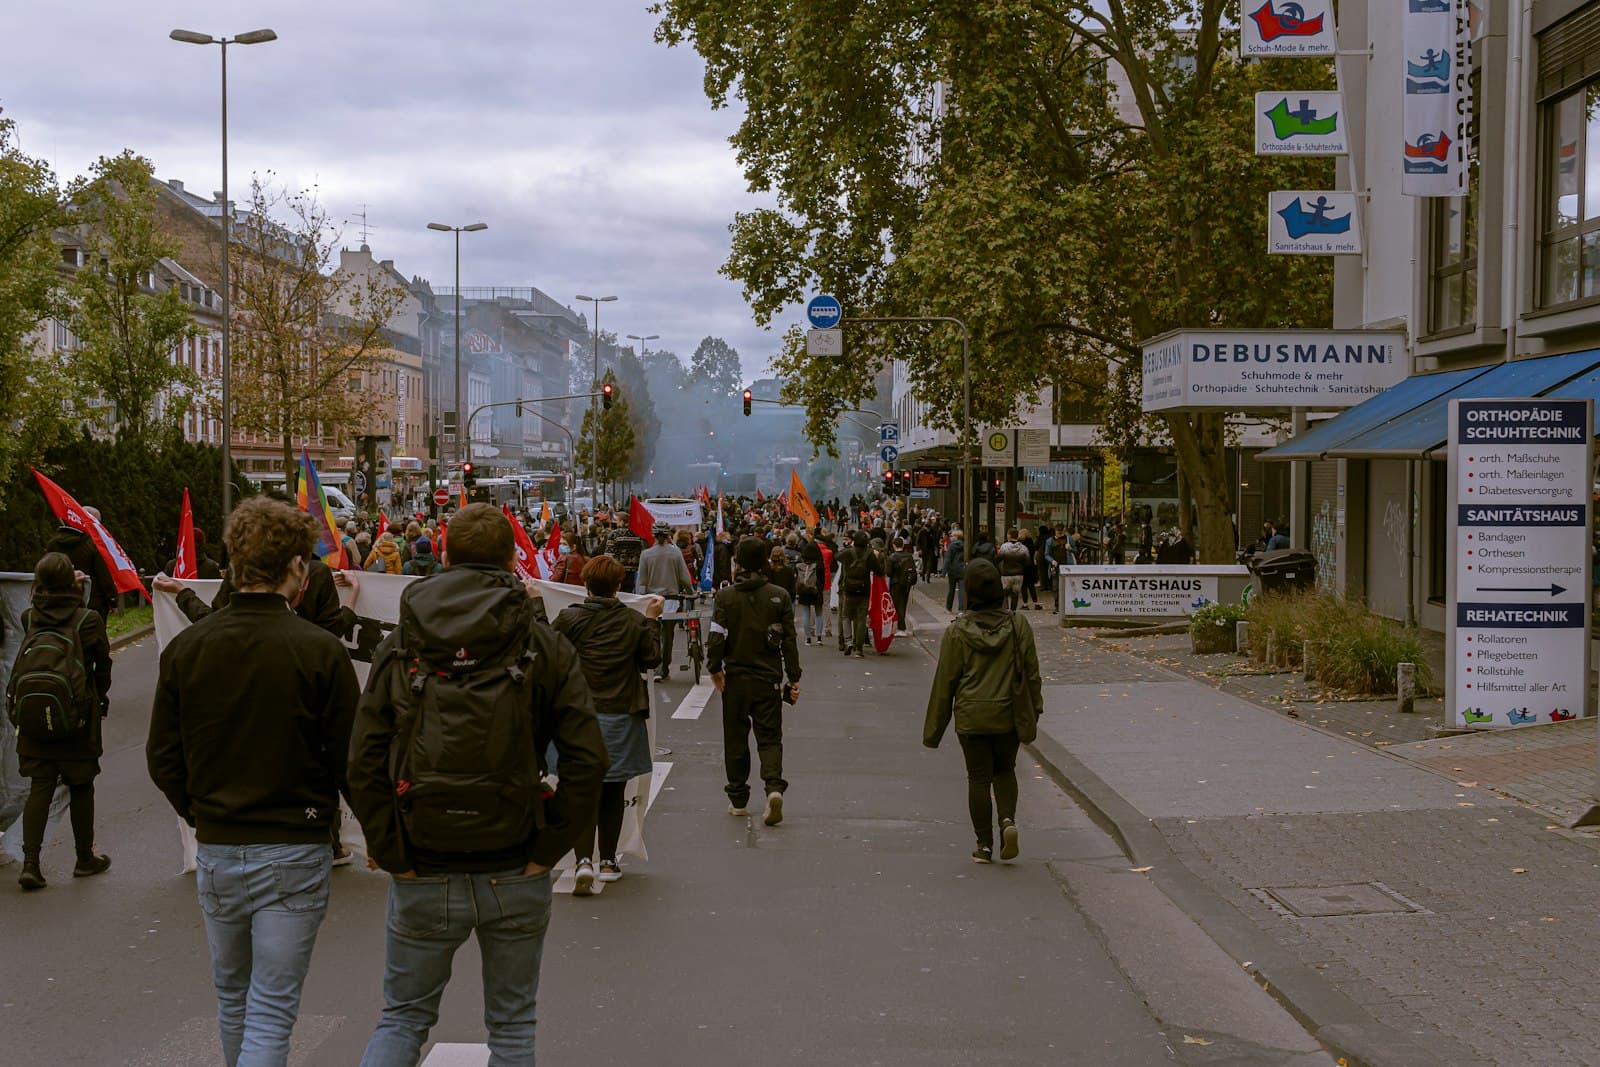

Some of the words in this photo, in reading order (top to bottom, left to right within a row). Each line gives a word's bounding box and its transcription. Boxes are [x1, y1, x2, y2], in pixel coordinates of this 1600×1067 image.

[1248, 44, 1296, 53] Schuh-Mode
[1261, 142, 1295, 151] Orthopädie
[1275, 241, 1323, 251] Sanitätshaus
[1326, 242, 1332, 251] &
[1192, 343, 1385, 363] DEBUSMANN
[1241, 371, 1301, 381] Schuhmode
[1304, 372, 1313, 381] &
[1316, 371, 1344, 381] mehr
[1192, 383, 1247, 394] Orthopädie
[1255, 384, 1319, 394] Schuhtechnik
[1466, 408, 1563, 422] ORTHOPÄDIE
[1466, 426, 1582, 439] SCHUHTECHNIK
[1479, 453, 1503, 463] orth.
[1507, 453, 1561, 463] Maßschuhe
[1479, 469, 1503, 479] orth.
[1506, 469, 1565, 481] Maßeinlagen
[1479, 485, 1573, 498] Diabetesversorgung
[1467, 507, 1579, 522] SANITÄTSHAUS
[1478, 532, 1526, 544] Bandagen
[1478, 548, 1526, 558] Orthesen
[1478, 564, 1582, 577] Kompressionstherapie
[1081, 576, 1202, 591] SANITÄTSHAUS
[1466, 610, 1568, 622] REHATECHNIK
[1477, 633, 1528, 644] Rollatoren
[1477, 649, 1538, 662] Pflegebetten
[1477, 665, 1525, 676] Rollstühle
[1476, 682, 1527, 692] Hilfsmittel
[1529, 682, 1548, 692] aller
[1551, 682, 1567, 692] Art
